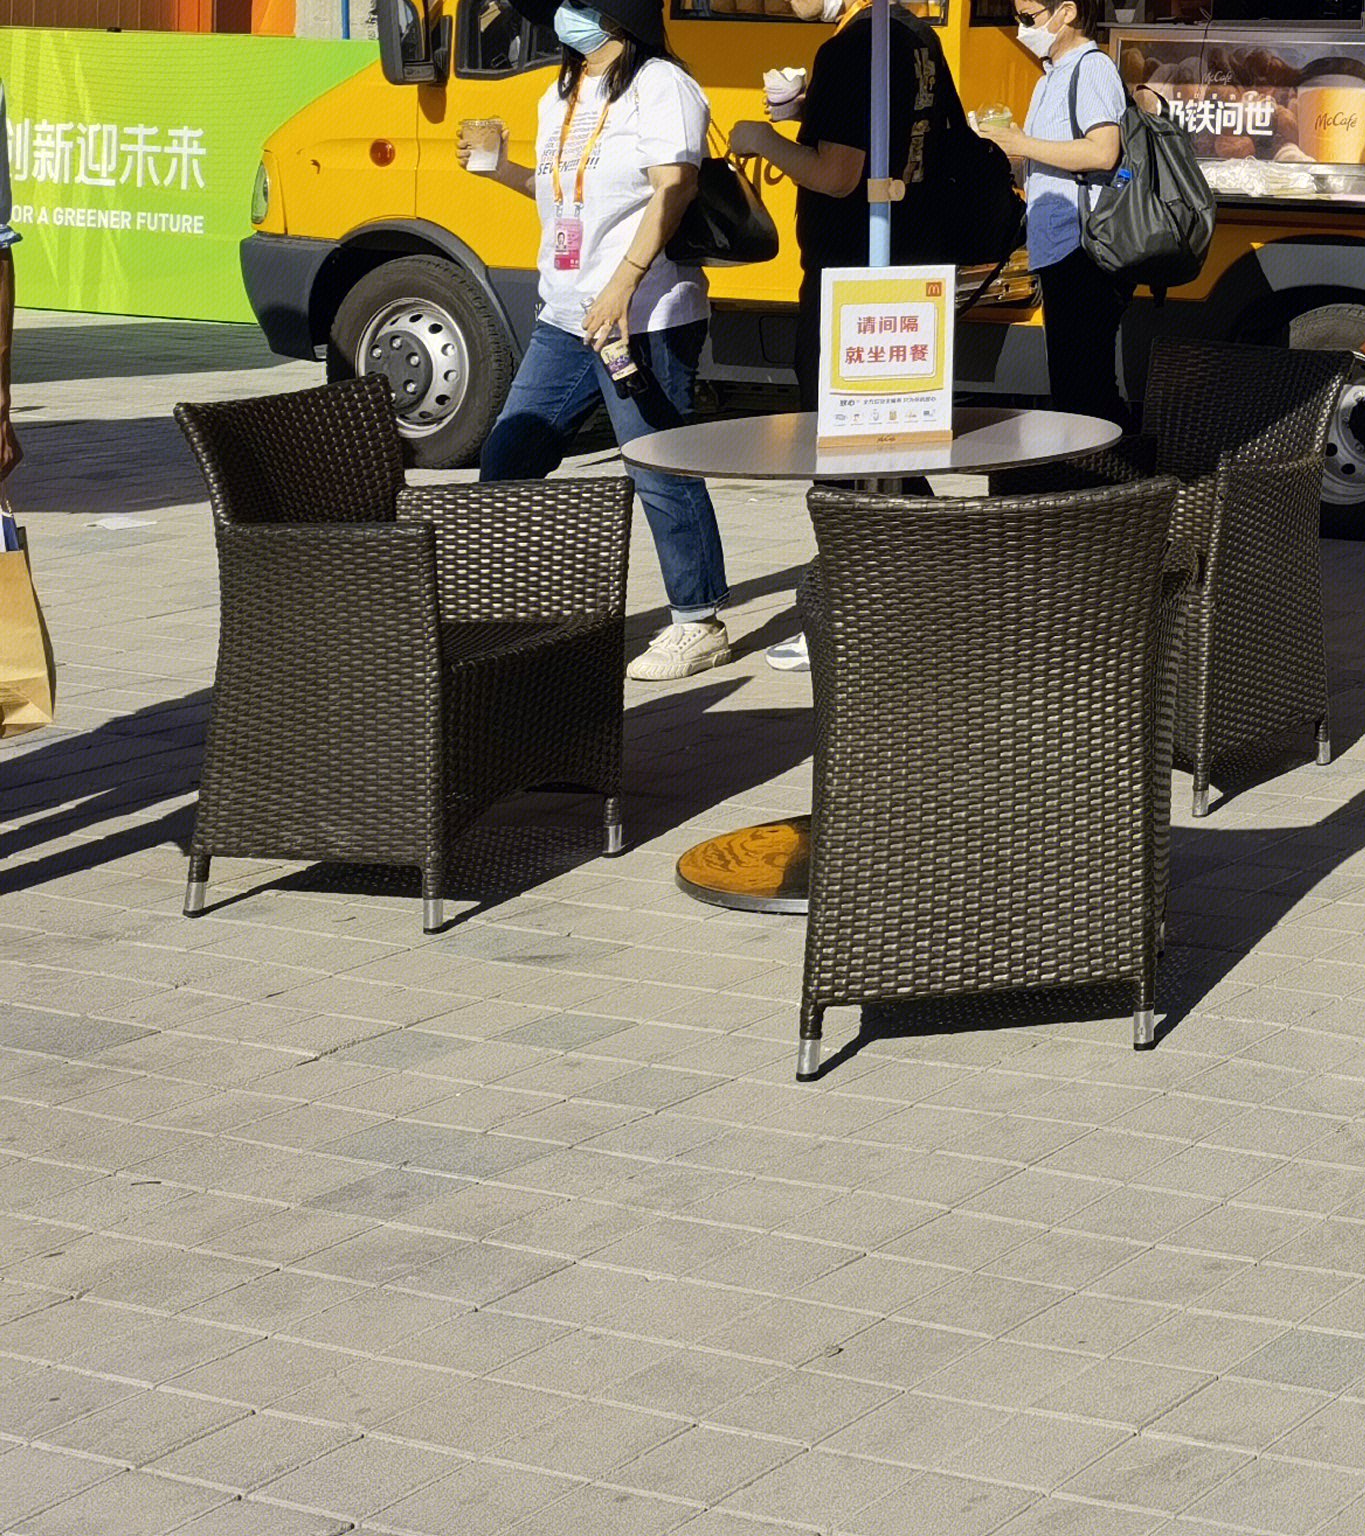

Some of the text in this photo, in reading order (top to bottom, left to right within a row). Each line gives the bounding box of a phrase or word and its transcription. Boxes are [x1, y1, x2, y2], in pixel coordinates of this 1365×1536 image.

[1314, 111, 1359, 131] McCafé
[11, 205, 204, 234] OR A GREENER FUTURE
[857, 315, 919, 335] 请间隔
[845, 344, 928, 364] 就坐用餐
